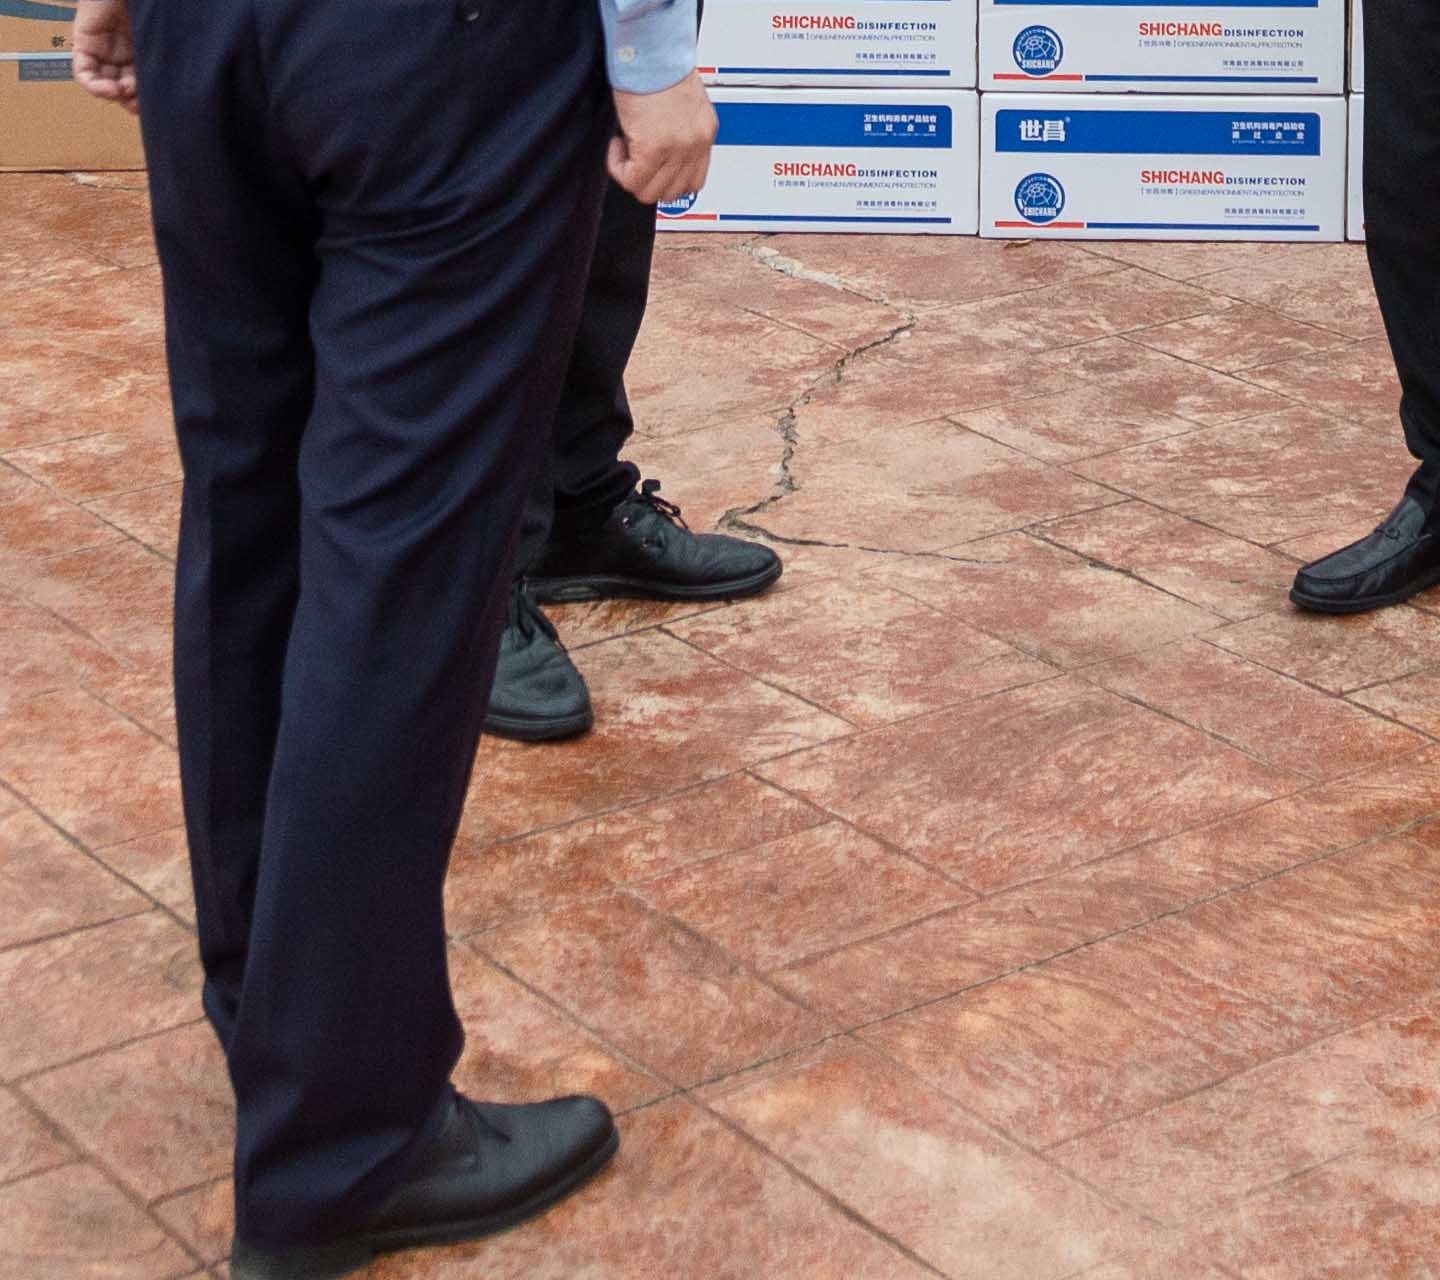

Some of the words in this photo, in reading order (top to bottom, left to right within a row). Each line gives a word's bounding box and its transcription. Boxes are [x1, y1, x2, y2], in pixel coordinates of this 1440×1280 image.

[771, 15, 855, 29] SHICHANG
[857, 21, 937, 30] DISINFECTION
[1138, 22, 1223, 36] SHICHANG
[1223, 28, 1304, 38] DISINFECTION
[1018, 119, 1066, 143] 世昌
[773, 163, 856, 177] SHICHANG
[857, 169, 938, 178] DISINFECTION
[1140, 170, 1225, 184] SHICHANG
[1225, 177, 1306, 186] DISINFECTION
